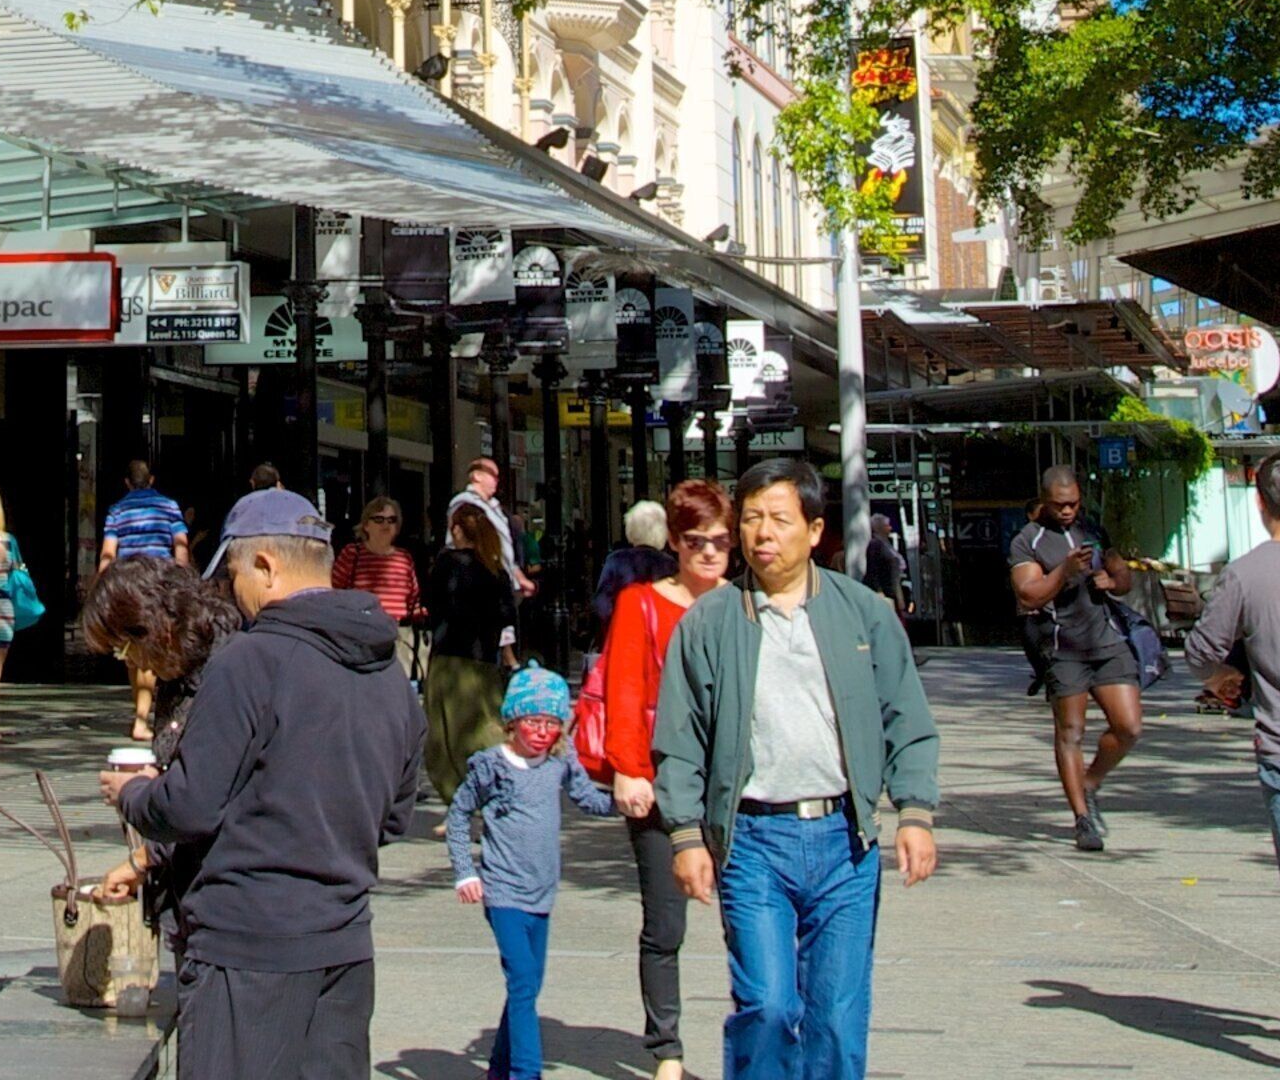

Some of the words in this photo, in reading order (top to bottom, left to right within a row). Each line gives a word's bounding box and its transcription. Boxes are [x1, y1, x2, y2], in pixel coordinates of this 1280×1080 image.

[461, 244, 497, 253] MYER
[175, 285, 231, 300] Billiard
[150, 330, 171, 340] Level
[197, 329, 225, 340] Queen
[1184, 325, 1262, 350] oasis
[272, 338, 324, 347] MYR
[263, 348, 333, 358] CENRE
[1108, 448, 1122, 464] B
